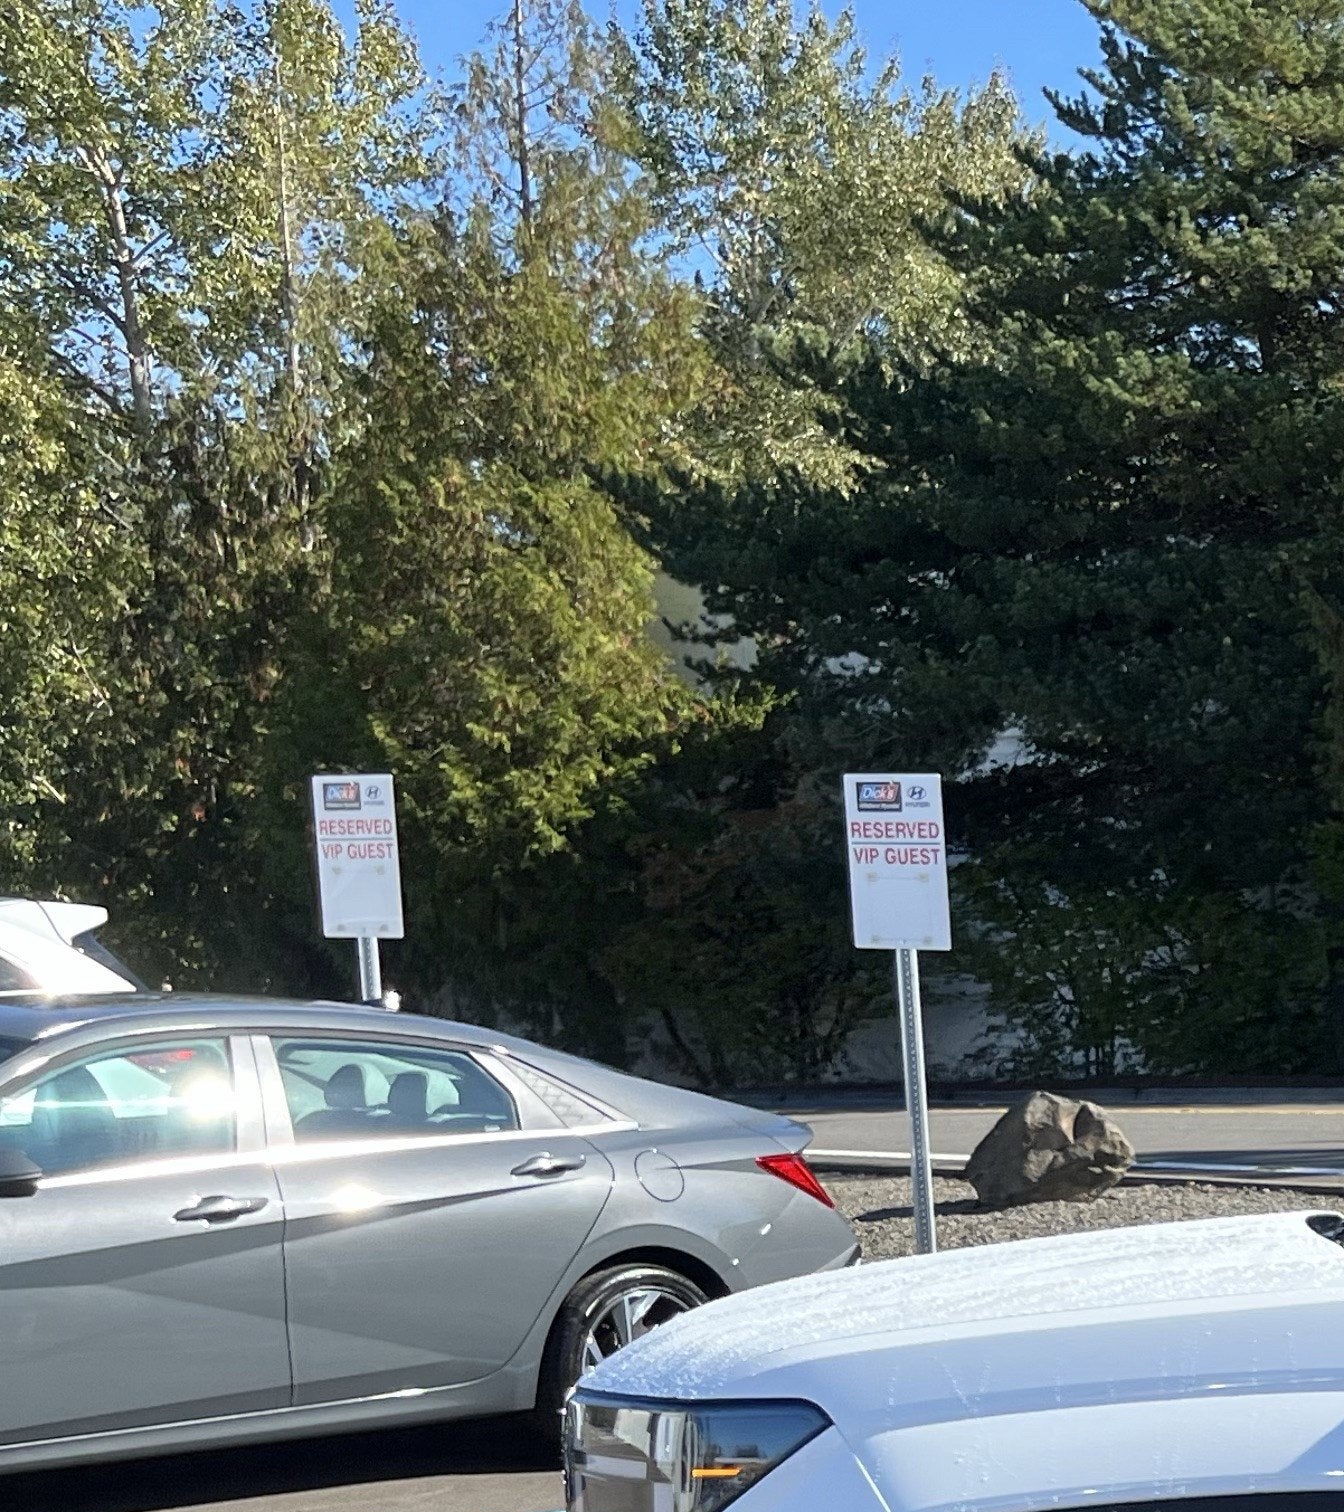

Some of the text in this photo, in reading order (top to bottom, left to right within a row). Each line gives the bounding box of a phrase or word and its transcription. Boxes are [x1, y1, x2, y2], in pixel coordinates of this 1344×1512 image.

[319, 819, 393, 836] RESERVED
[850, 822, 940, 839] RESERVED
[321, 842, 395, 860] VIP GUEST
[853, 847, 941, 865] VIP GUEST
